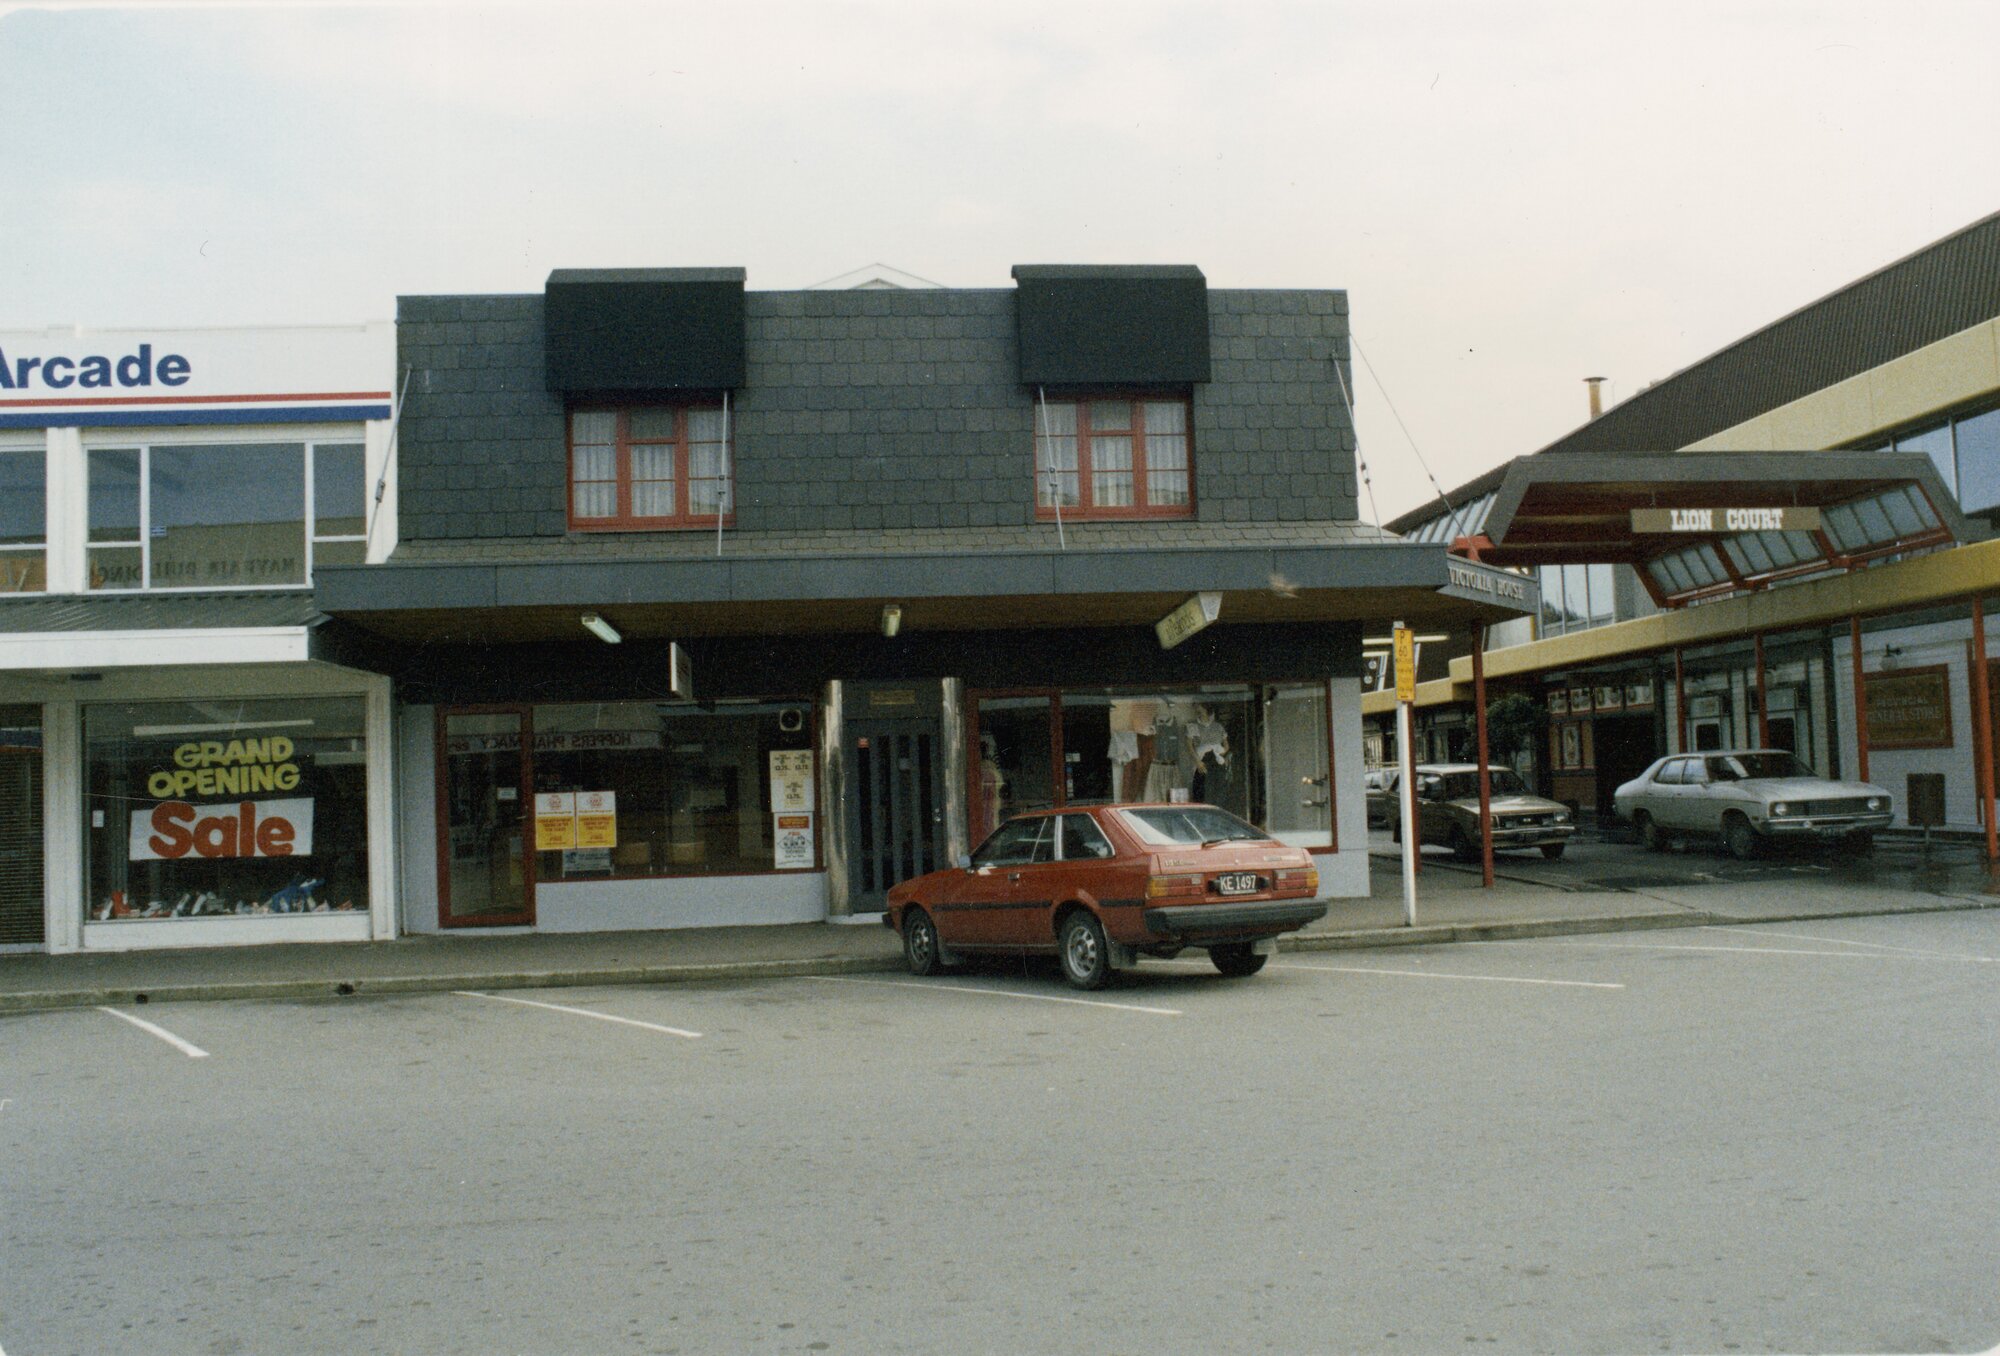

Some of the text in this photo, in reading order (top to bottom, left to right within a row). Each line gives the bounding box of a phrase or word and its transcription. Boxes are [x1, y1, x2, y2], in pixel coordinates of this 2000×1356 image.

[1670, 507, 1783, 531] LION COURT
[1448, 566, 1524, 601] VICTORIA HOUSE
[1910, 705, 1942, 720] STORE
[174, 736, 294, 768] GRAND
[148, 763, 300, 798] OPENING
[148, 801, 295, 859] Sale
[1220, 874, 1257, 890] KE 1497
